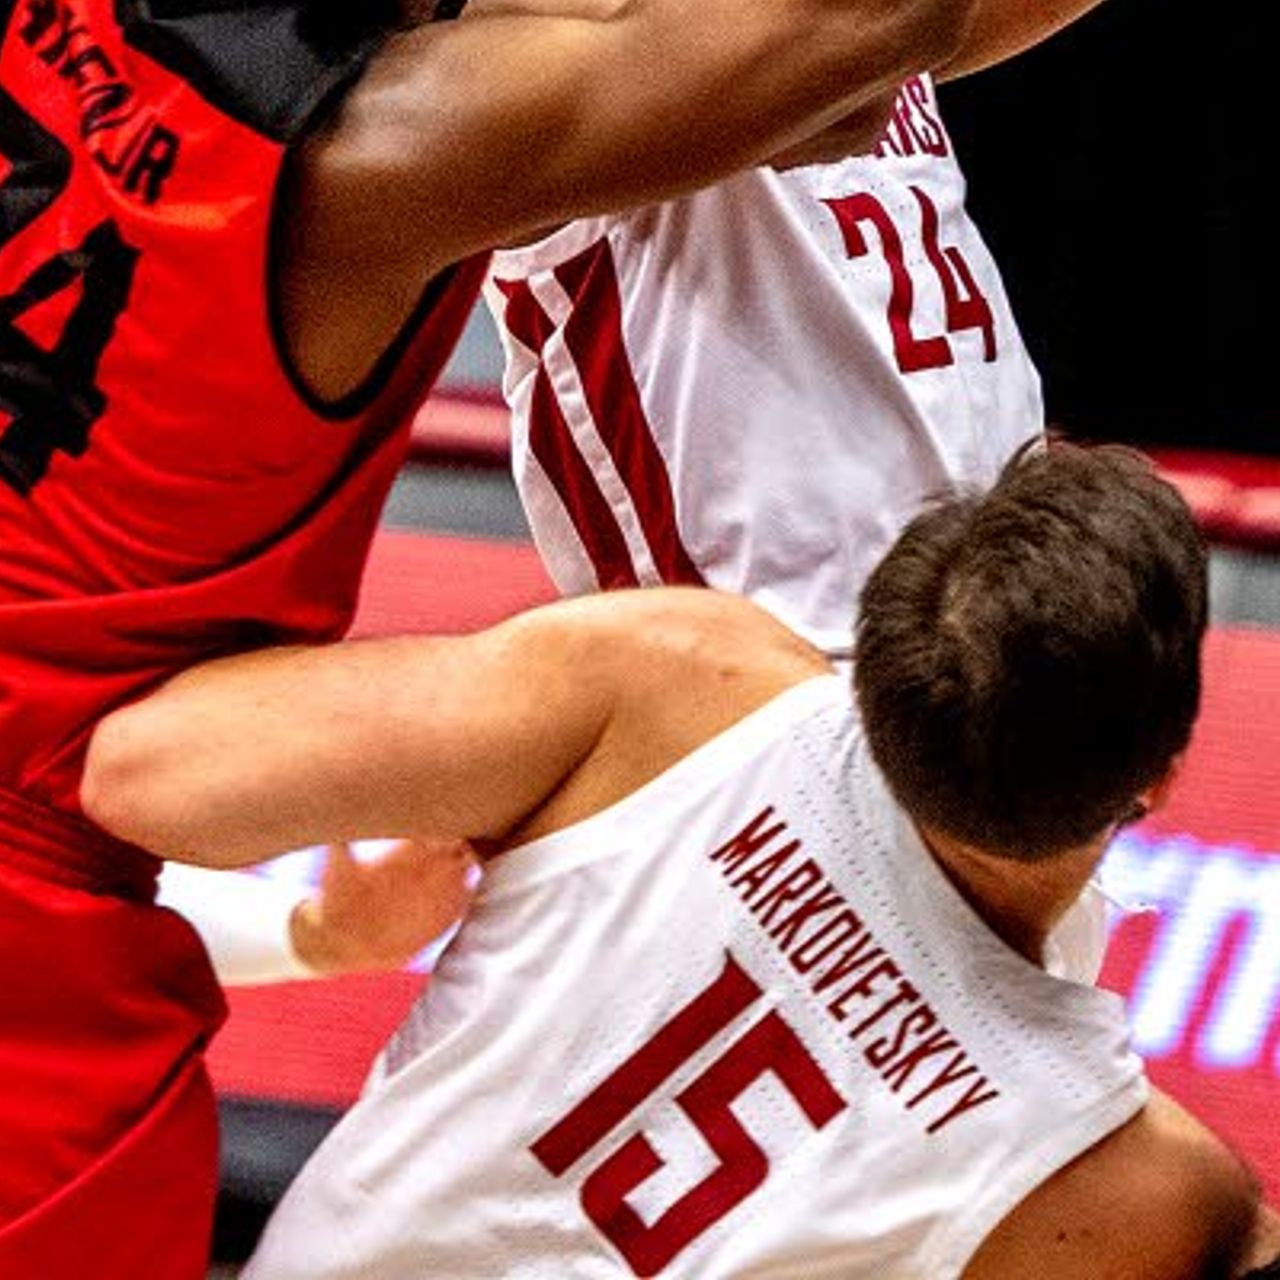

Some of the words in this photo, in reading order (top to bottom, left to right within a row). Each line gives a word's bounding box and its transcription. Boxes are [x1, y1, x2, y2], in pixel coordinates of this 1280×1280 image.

[820, 184, 998, 375] 24
[528, 946, 848, 1280] 15
[707, 804, 1000, 1136] MARKOVETSKYY
